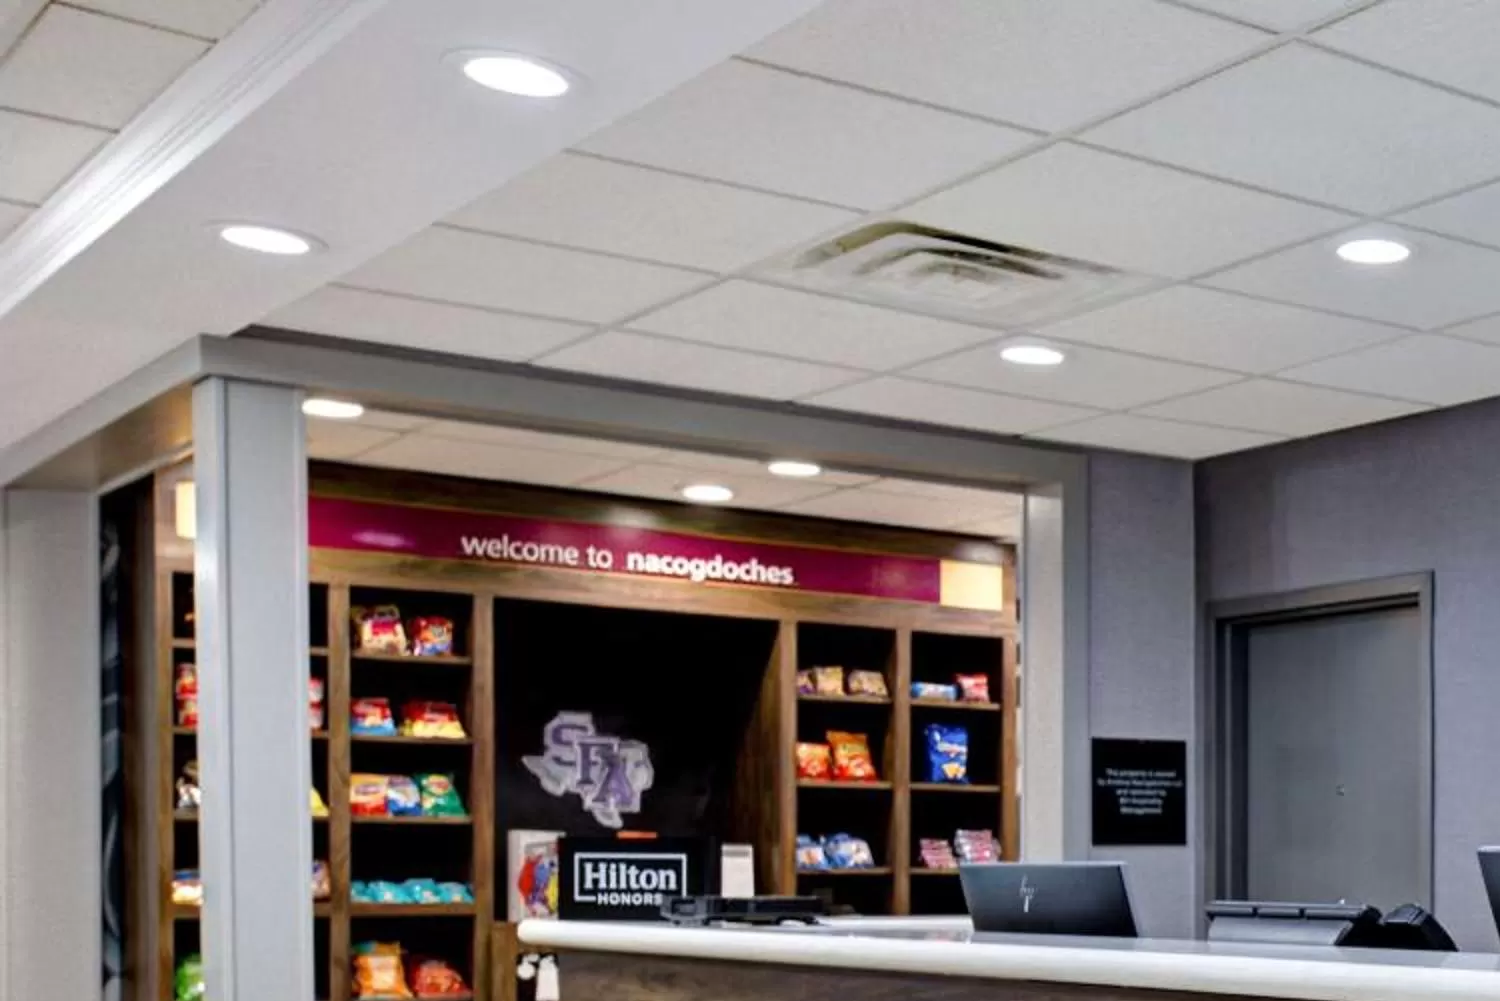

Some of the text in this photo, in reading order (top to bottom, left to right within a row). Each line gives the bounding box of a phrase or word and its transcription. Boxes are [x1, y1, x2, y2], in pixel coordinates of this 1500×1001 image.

[461, 534, 793, 584] welcome to nacogdoches
[583, 862, 677, 890] Hilton
[597, 894, 663, 906] HONORS
